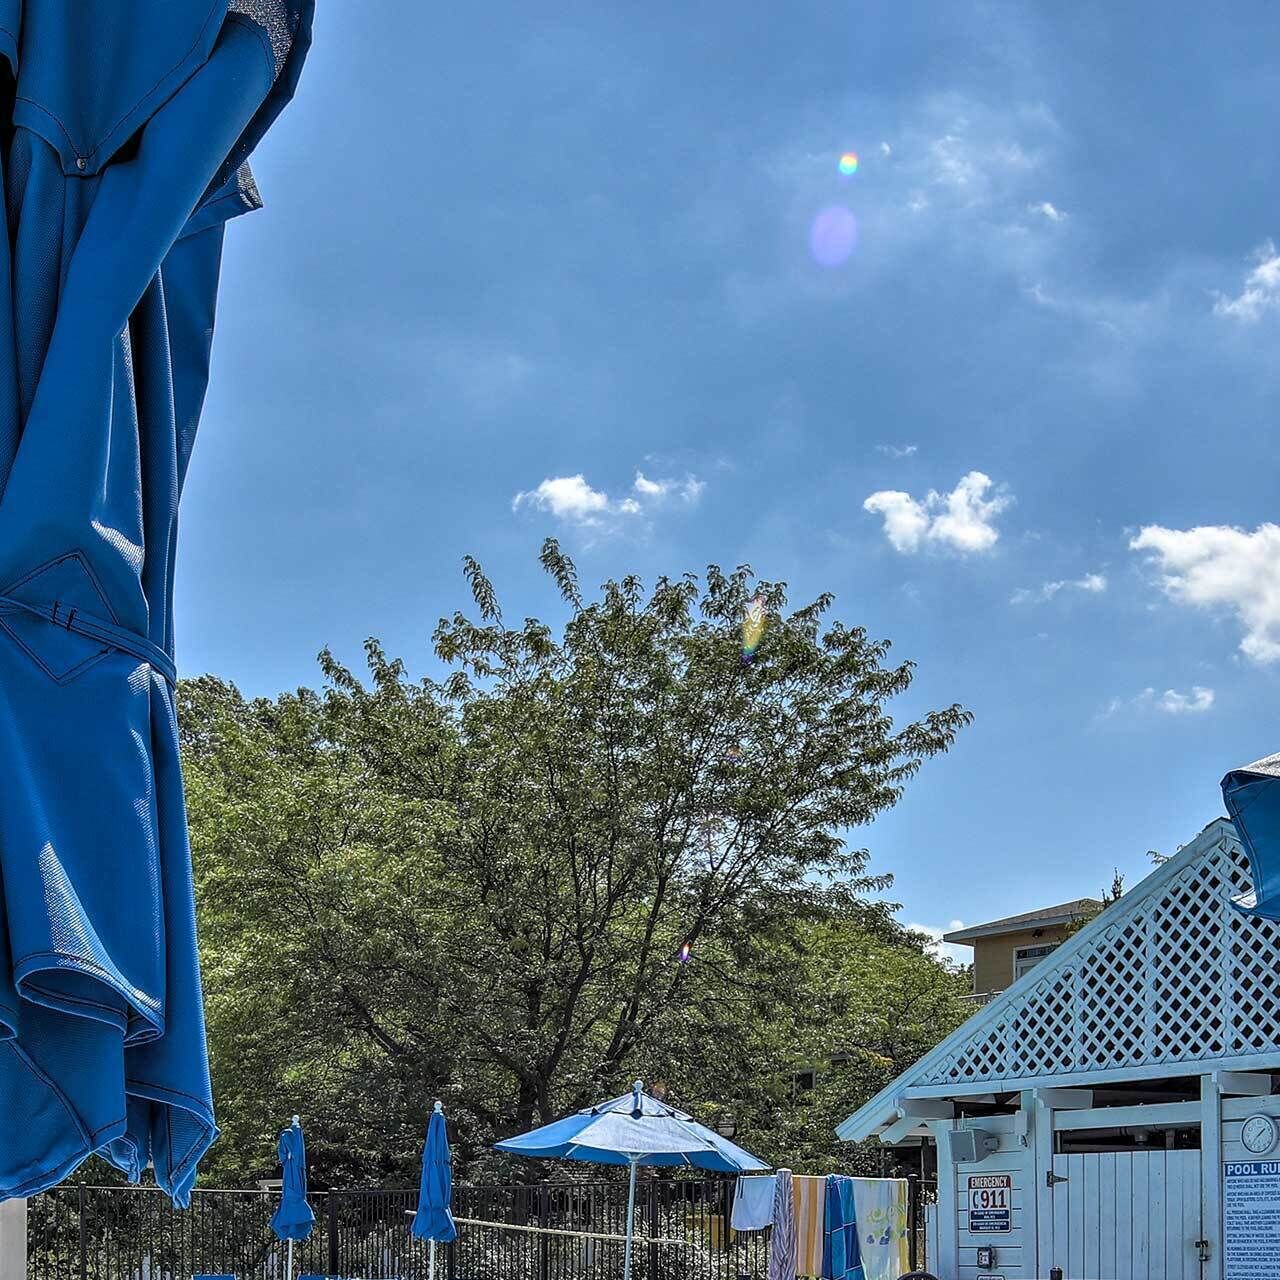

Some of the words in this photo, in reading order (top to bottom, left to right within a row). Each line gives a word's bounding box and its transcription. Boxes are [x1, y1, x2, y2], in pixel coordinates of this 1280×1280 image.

[1227, 1164, 1258, 1175] POOL
[971, 1177, 1008, 1188] EMERGENCY
[980, 1189, 1007, 1209] 911
